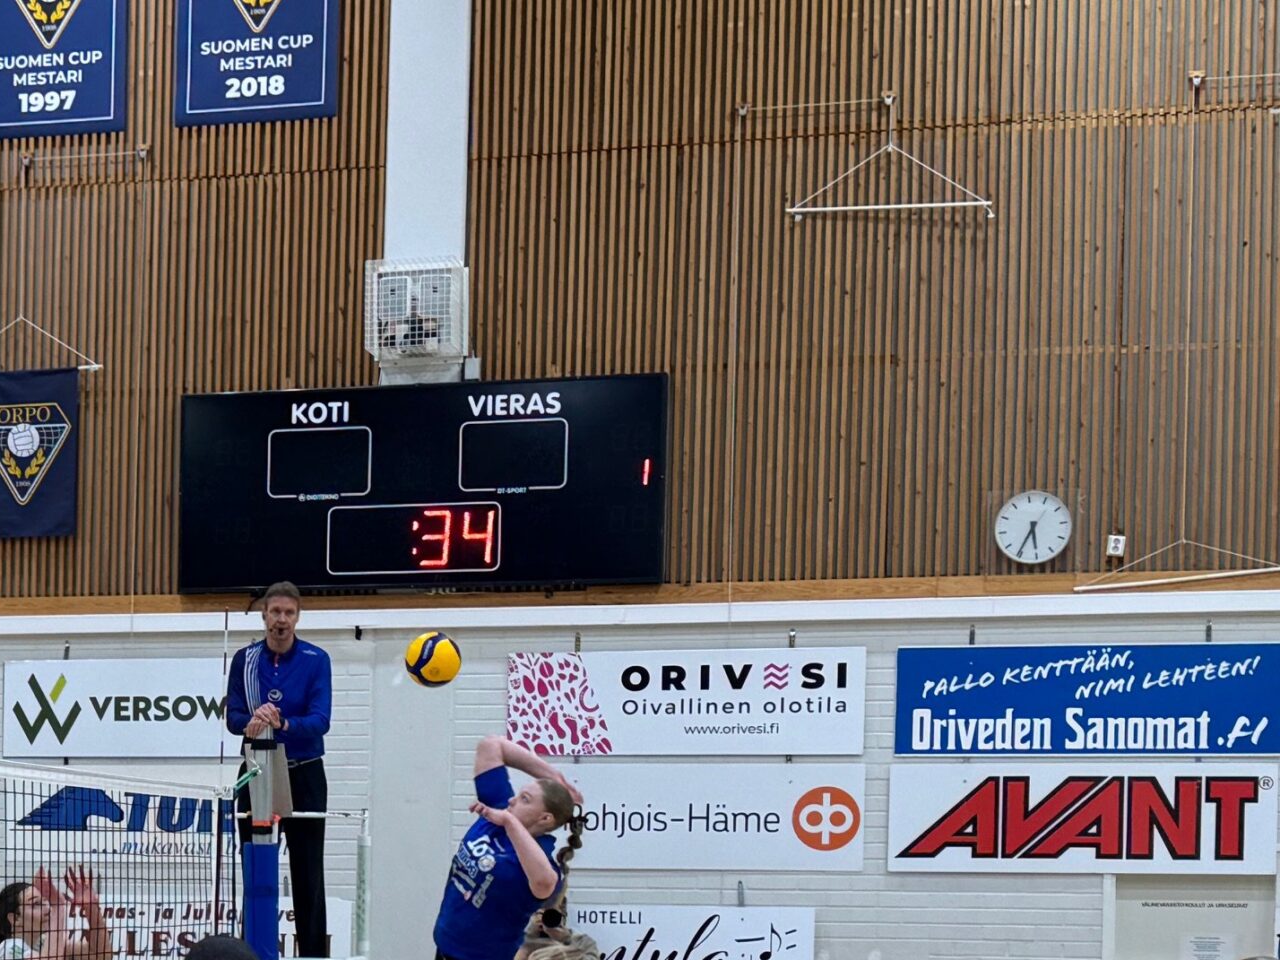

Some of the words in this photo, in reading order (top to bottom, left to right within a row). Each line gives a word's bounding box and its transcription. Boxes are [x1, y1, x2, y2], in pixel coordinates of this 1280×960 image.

[200, 37, 273, 56] SUOMEN
[276, 34, 314, 50] CUP
[68, 50, 103, 67] CUP
[219, 54, 293, 72] MESTARI
[12, 69, 83, 87] MESTARI
[224, 75, 285, 99] 2018
[17, 90, 77, 113] 1997
[290, 401, 351, 425] KOTI
[467, 392, 562, 417] VIERAS
[922, 671, 995, 699] PALLO
[1002, 648, 1136, 687] KENTTÄÄN,
[1075, 674, 1134, 700] NIMI
[1142, 656, 1261, 690] LEHTEEN!
[622, 697, 751, 717] Oivallinen
[763, 696, 848, 714] olotila
[683, 722, 780, 737] www.orivesi.fi
[912, 707, 1053, 750] Oriveden
[1064, 706, 1211, 750] Sanomat
[895, 775, 1260, 861] AVANT
[577, 909, 642, 925] HOTELLI
